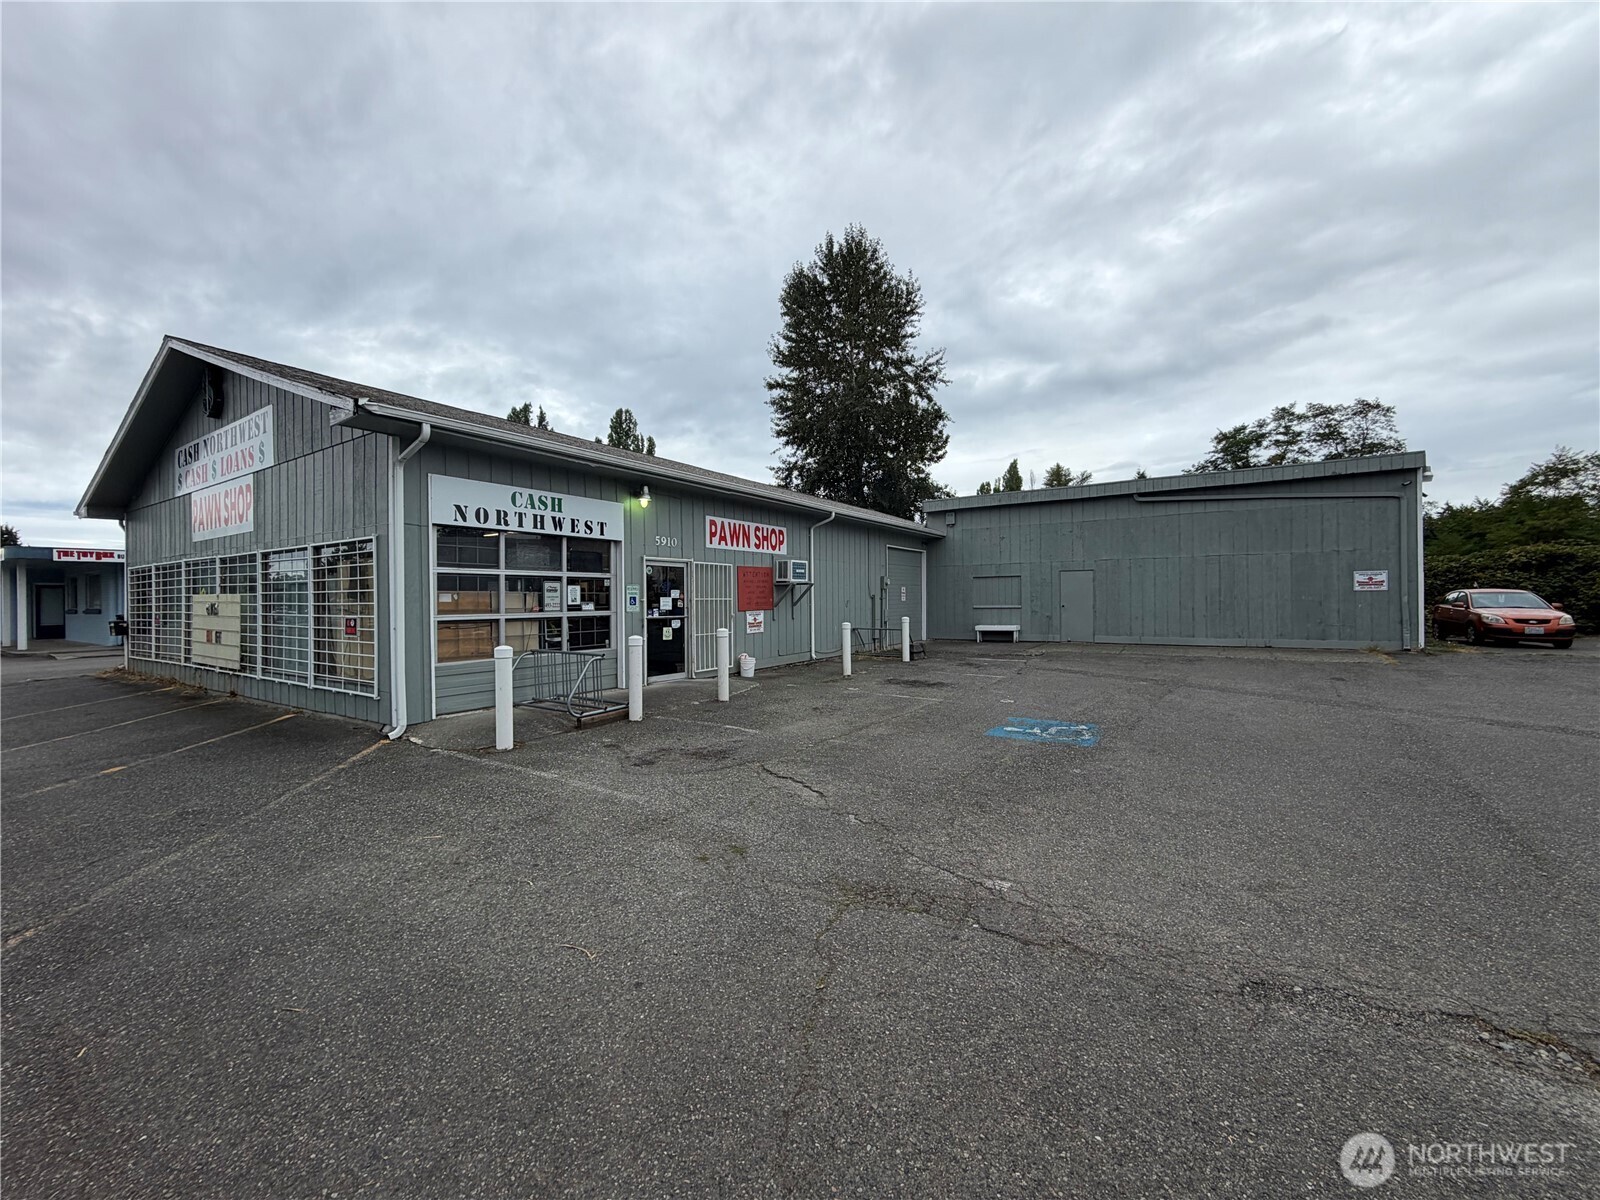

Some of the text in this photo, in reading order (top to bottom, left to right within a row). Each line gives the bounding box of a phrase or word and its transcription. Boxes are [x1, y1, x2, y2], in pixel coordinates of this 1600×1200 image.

[177, 411, 269, 469] CASH NORTHWEST
[184, 463, 208, 489] CASH
[220, 445, 255, 477] LOANS
[192, 483, 252, 534] PAWN SHOP
[510, 490, 563, 514] CASH
[453, 504, 608, 537] NORTHWEST
[709, 518, 785, 552] PAWN SHOP
[655, 535, 678, 548] 5910
